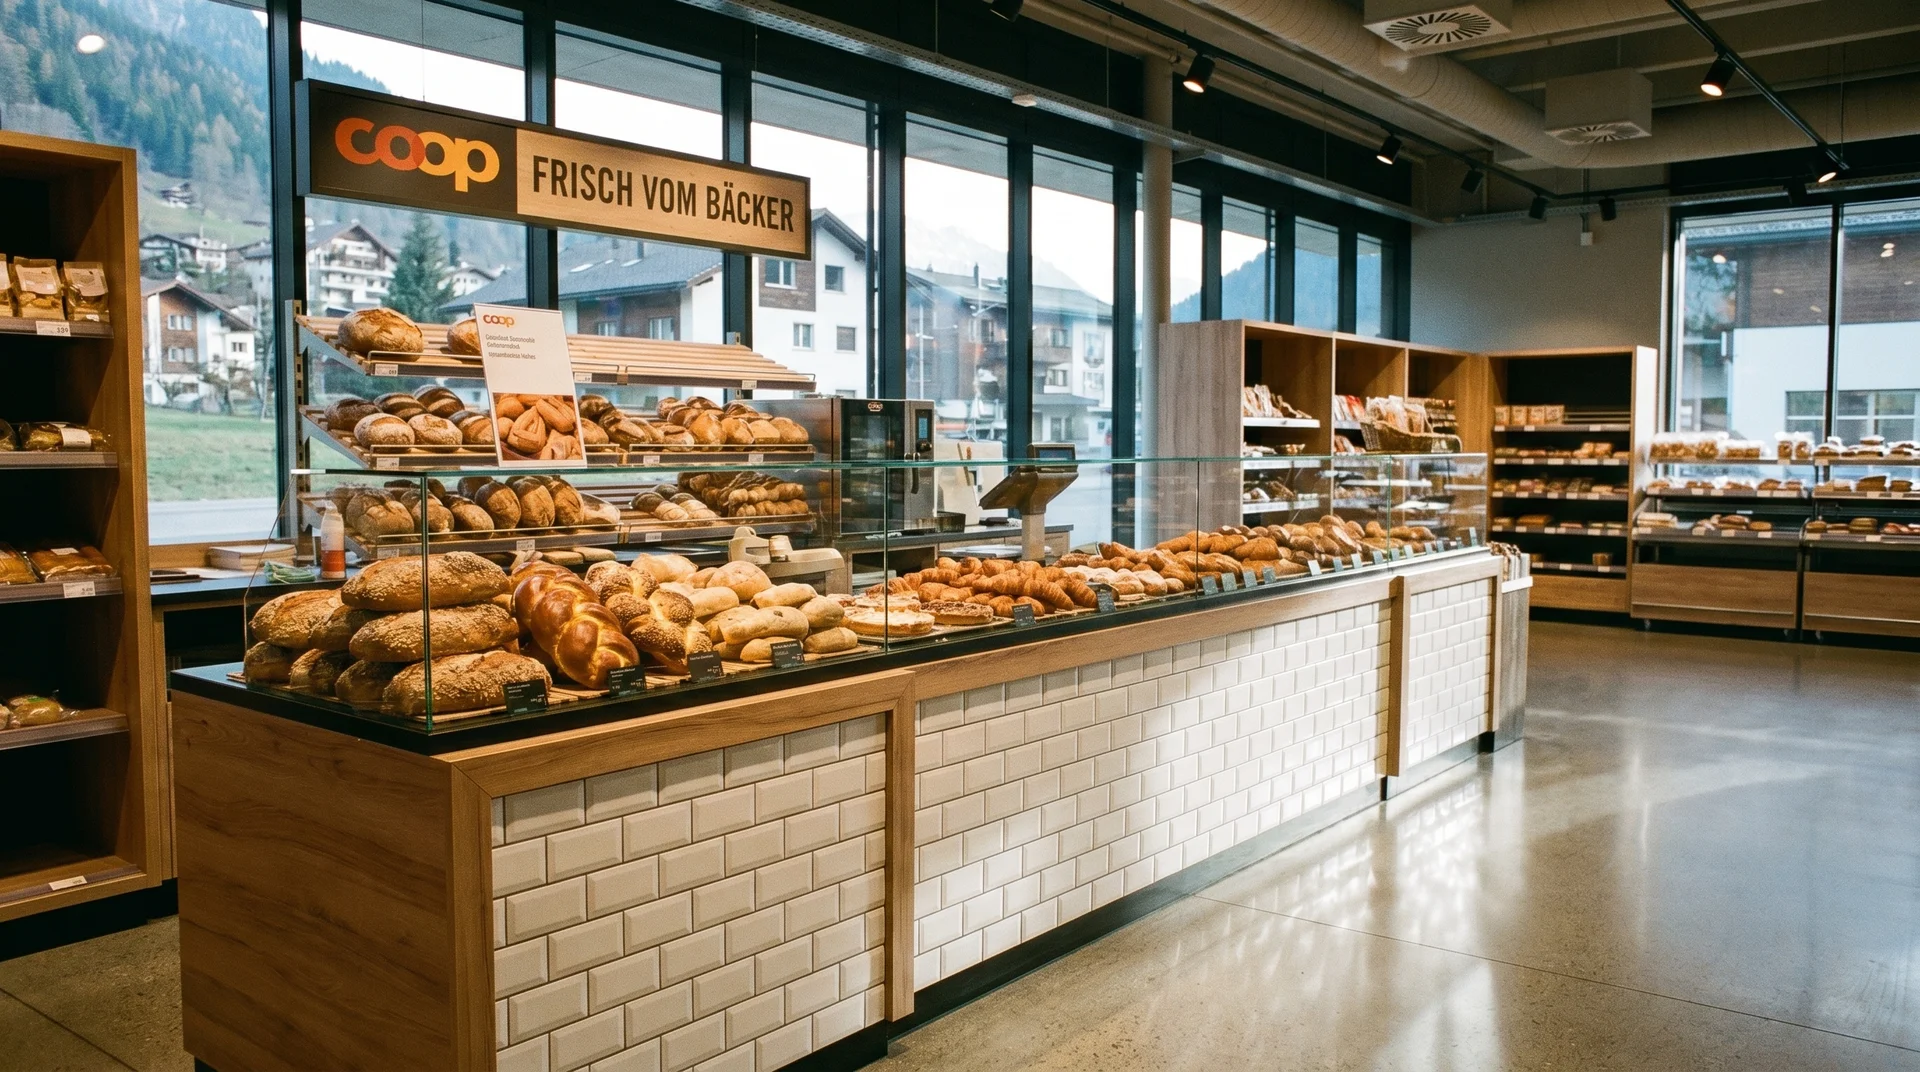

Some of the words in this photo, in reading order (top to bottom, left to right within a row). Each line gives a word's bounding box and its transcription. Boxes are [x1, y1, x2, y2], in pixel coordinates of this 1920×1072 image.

[335, 117, 500, 192] coop
[533, 155, 633, 207] FRISCH
[642, 174, 696, 217] VOM
[706, 181, 795, 233] BÄCKER
[483, 314, 515, 328] coop
